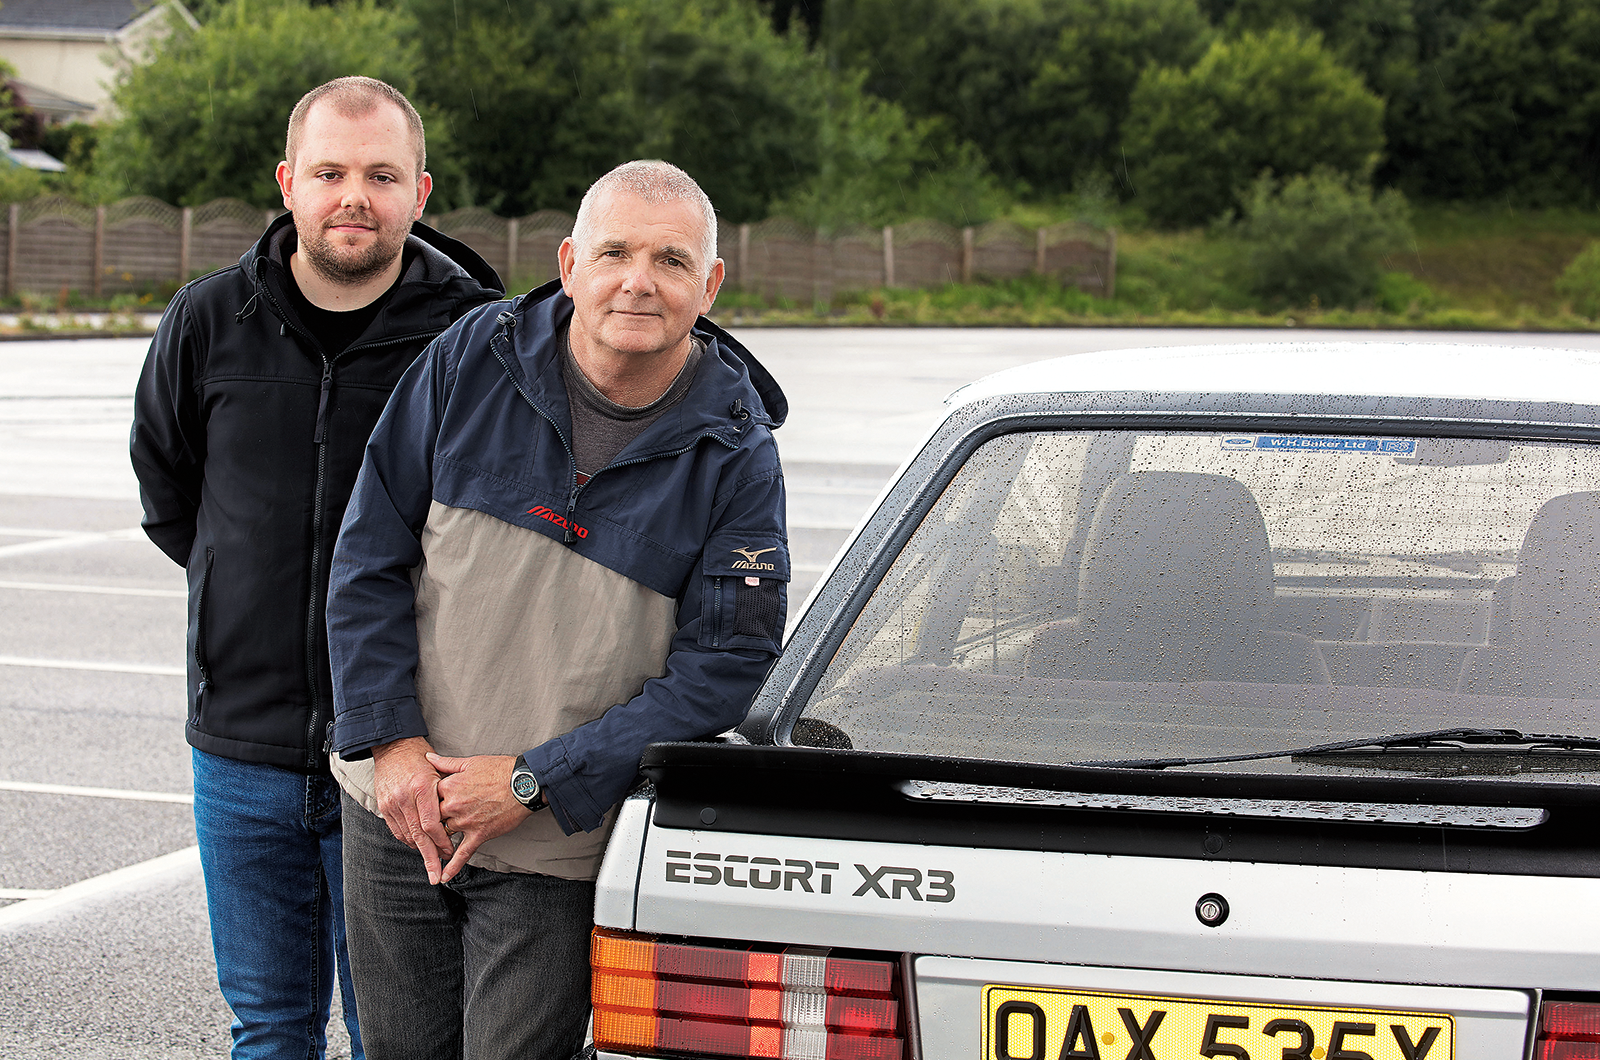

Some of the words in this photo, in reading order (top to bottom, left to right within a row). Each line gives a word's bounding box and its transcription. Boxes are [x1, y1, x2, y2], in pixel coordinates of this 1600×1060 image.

[1344, 441, 1367, 449] Ltd
[665, 849, 840, 895] ESCORT
[851, 863, 956, 904] XR3
[995, 1000, 1168, 1060] OAX
